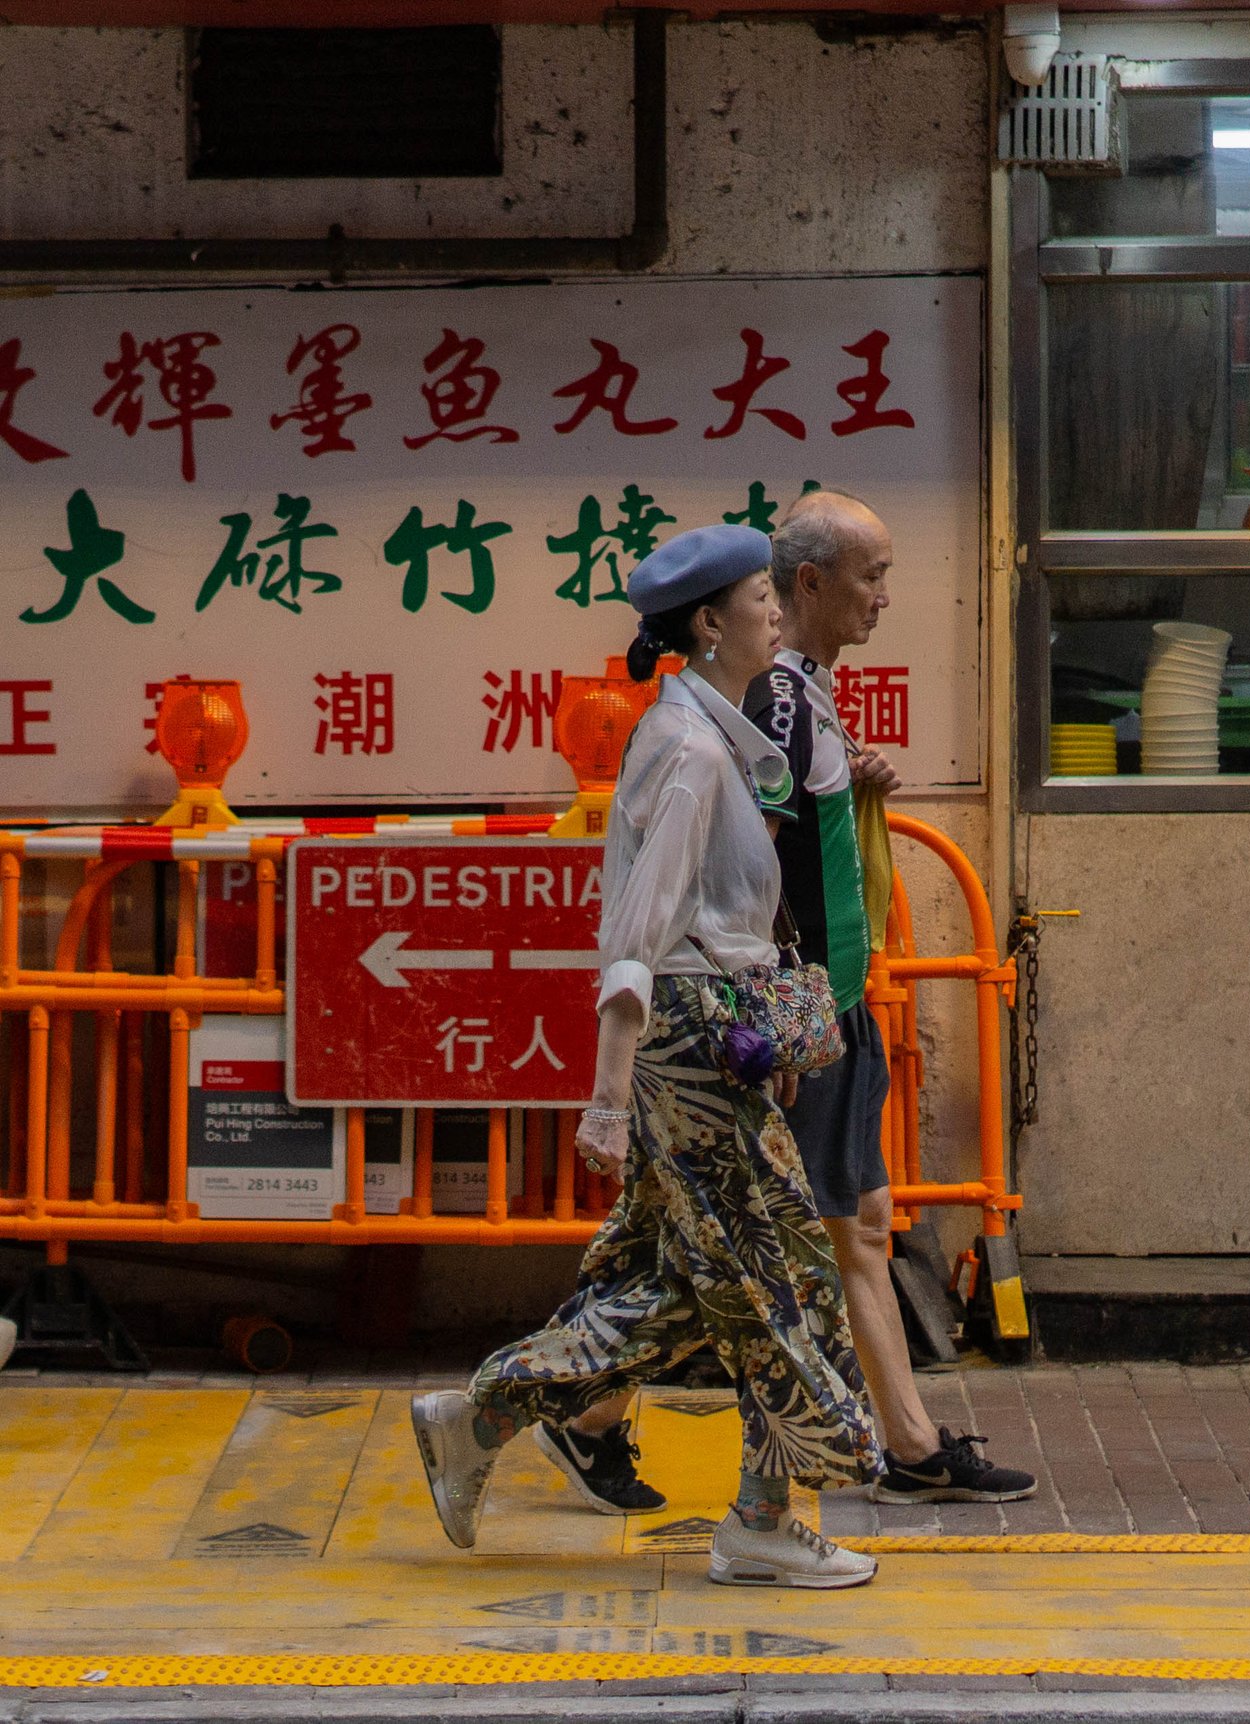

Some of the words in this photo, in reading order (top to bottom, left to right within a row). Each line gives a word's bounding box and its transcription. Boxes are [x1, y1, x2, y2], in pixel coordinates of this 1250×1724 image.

[435, 1015, 565, 1073] 行人
[205, 1117, 224, 1129] Pui
[226, 1118, 253, 1131] Hing
[254, 1118, 325, 1130] Construction
[247, 1178, 280, 1191] 2814
[285, 1179, 318, 1192] 3443
